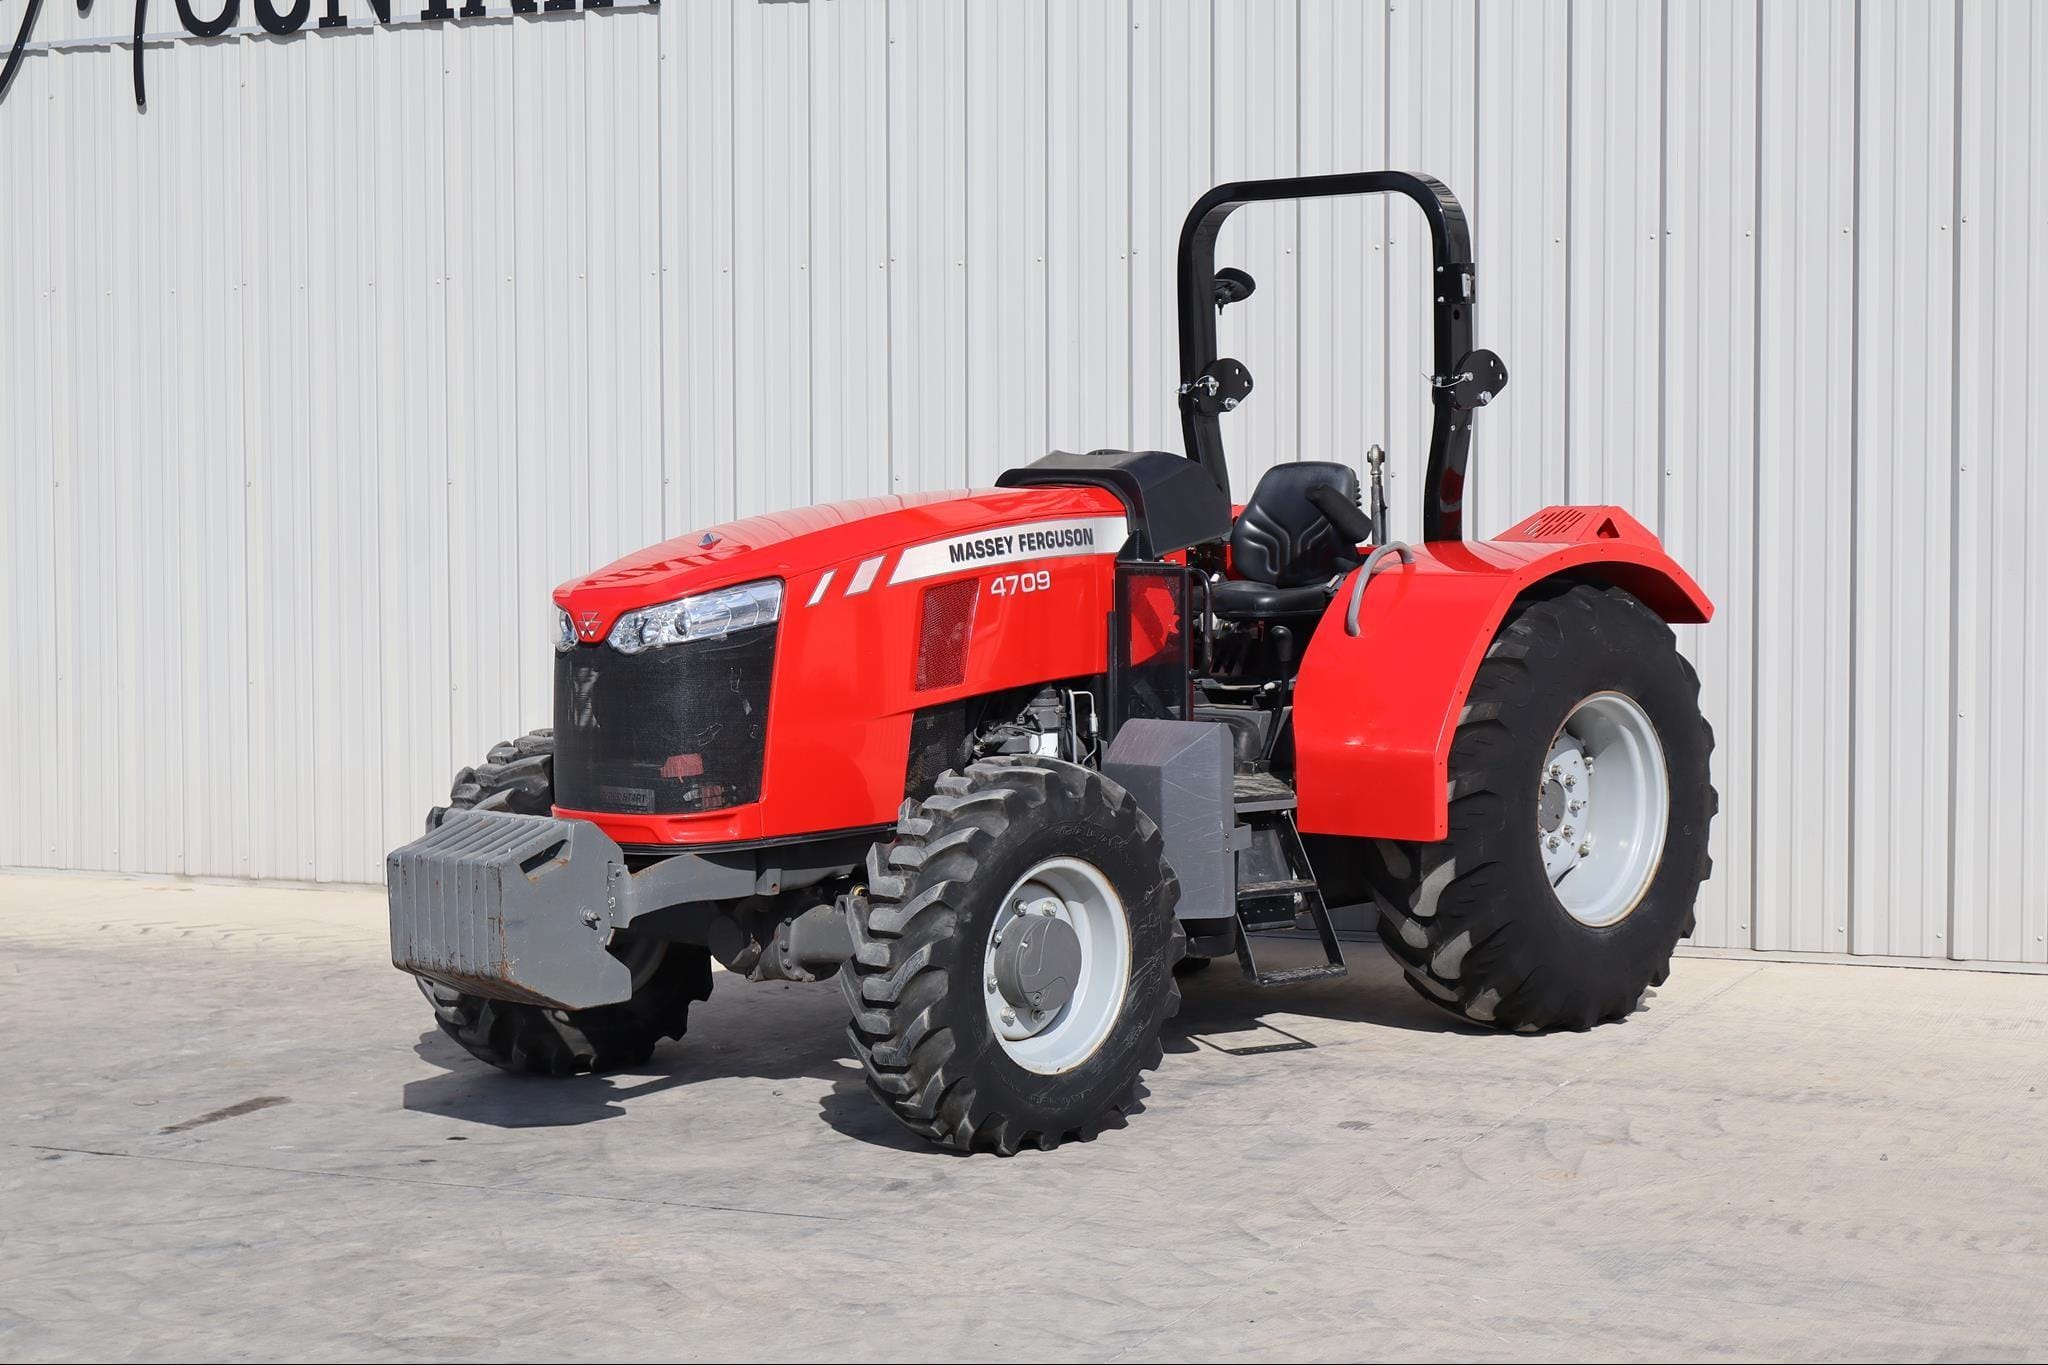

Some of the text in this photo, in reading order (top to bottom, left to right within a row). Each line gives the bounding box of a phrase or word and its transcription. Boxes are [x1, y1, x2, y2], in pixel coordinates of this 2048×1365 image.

[949, 528, 1094, 563] MASSEY FERGUSON
[990, 570, 1051, 596] 4709
